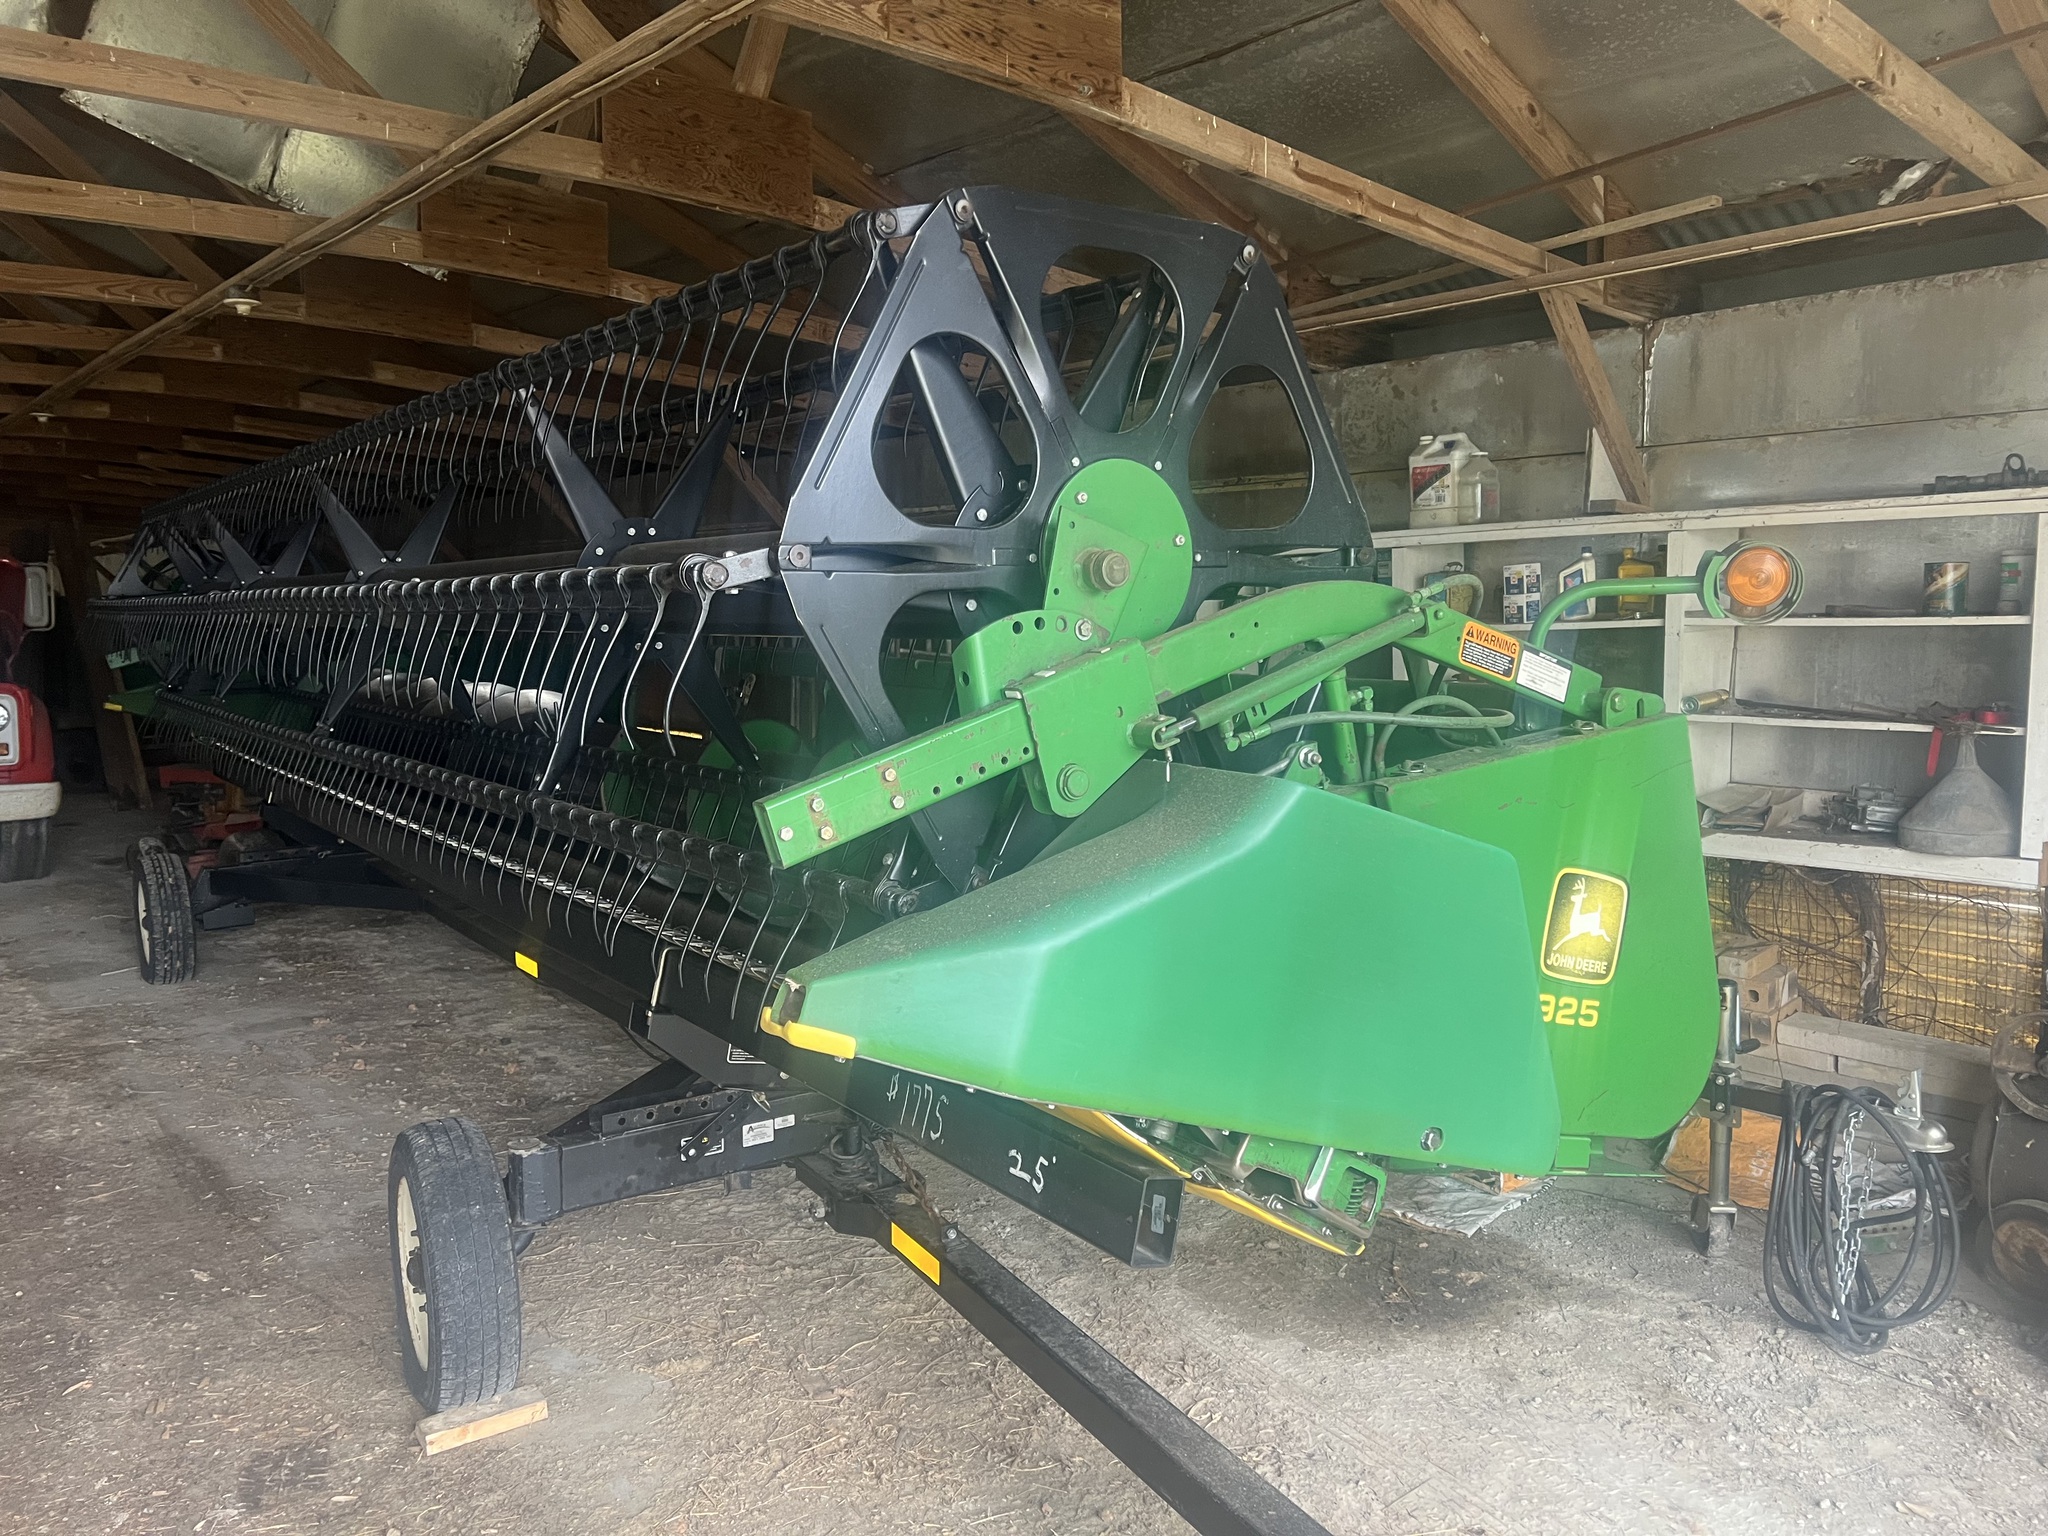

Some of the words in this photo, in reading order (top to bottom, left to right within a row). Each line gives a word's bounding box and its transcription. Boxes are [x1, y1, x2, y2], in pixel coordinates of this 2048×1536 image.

[1476, 628, 1518, 655] WARNING
[1546, 952, 1575, 970] JOHN
[1575, 957, 1608, 975] DEERE
[1539, 993, 1600, 1028] 925
